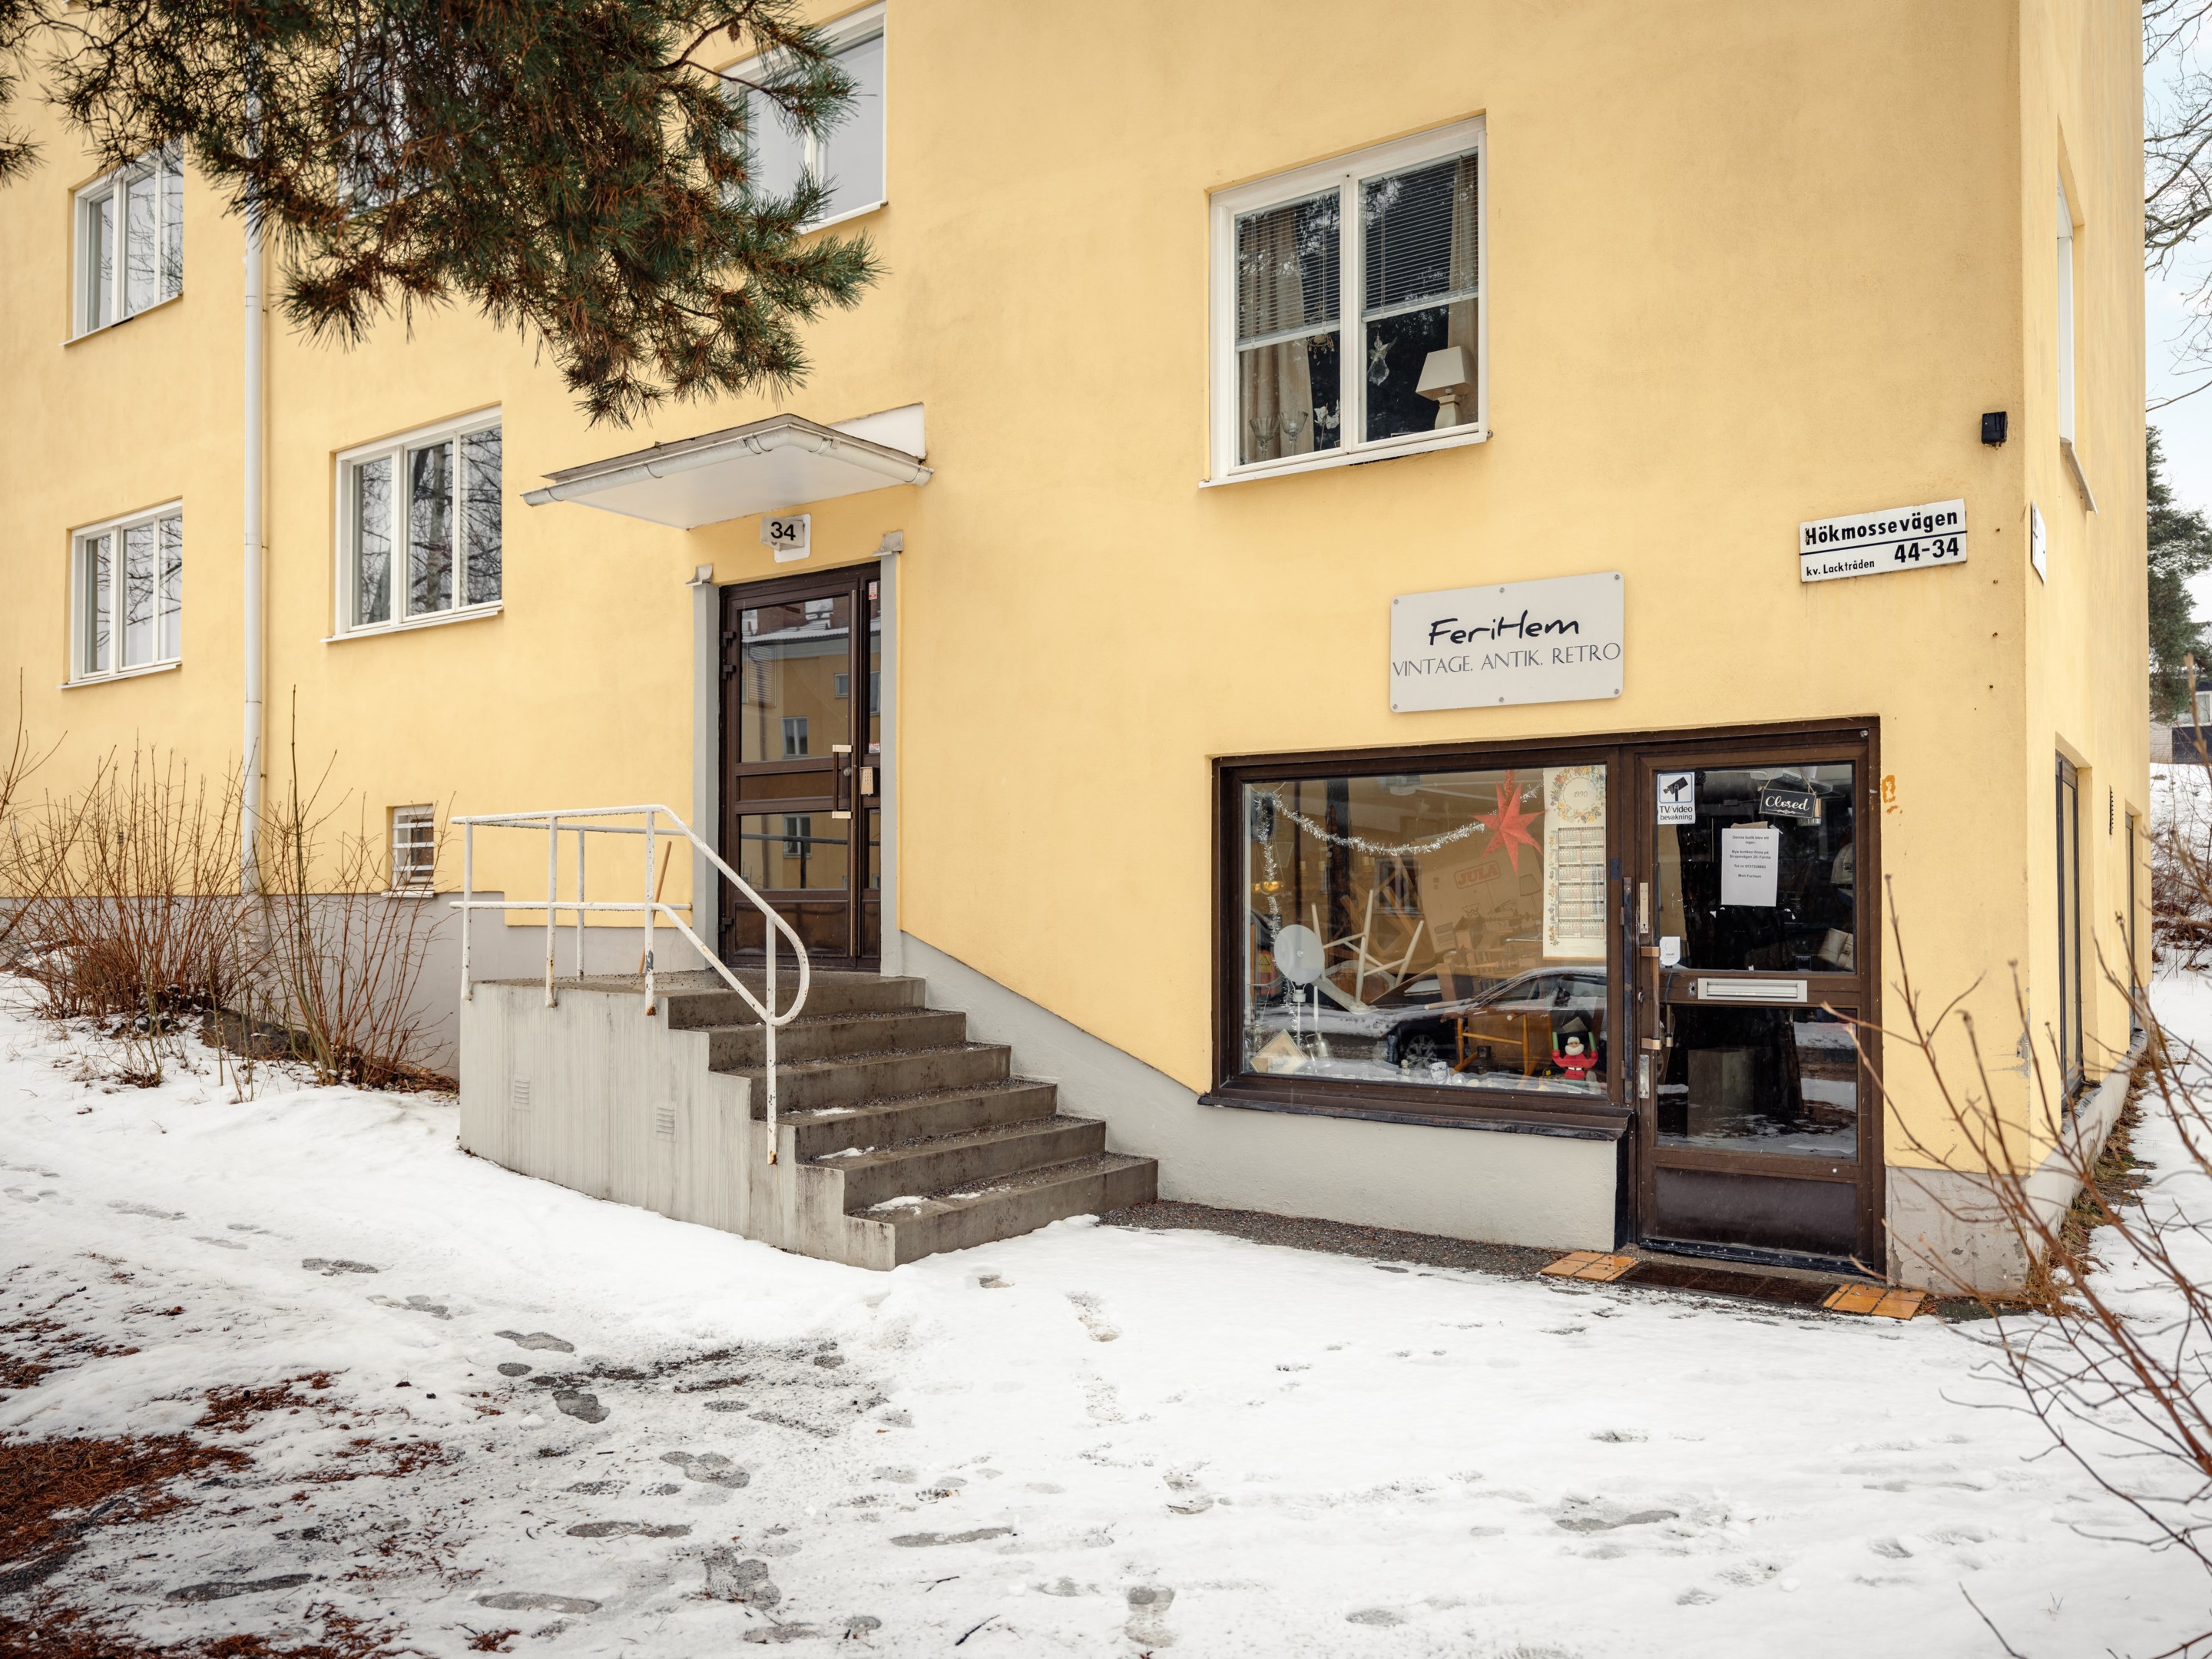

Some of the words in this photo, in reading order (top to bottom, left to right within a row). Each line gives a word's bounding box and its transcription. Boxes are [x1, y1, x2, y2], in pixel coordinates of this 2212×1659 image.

[770, 521, 796, 541] 34
[1805, 512, 1958, 545] Hökmossevägen
[1806, 567, 1820, 576] kv.
[1894, 537, 1959, 563] 44-34
[1429, 609, 1580, 646] FeriHem
[1392, 655, 1474, 677] VINTAGE.
[1481, 649, 1544, 670] ANTIK.
[1551, 642, 1621, 664] RETRO
[1659, 805, 1693, 813] TV/video
[1765, 795, 1810, 811] Closed
[1458, 863, 1500, 886] JULA
